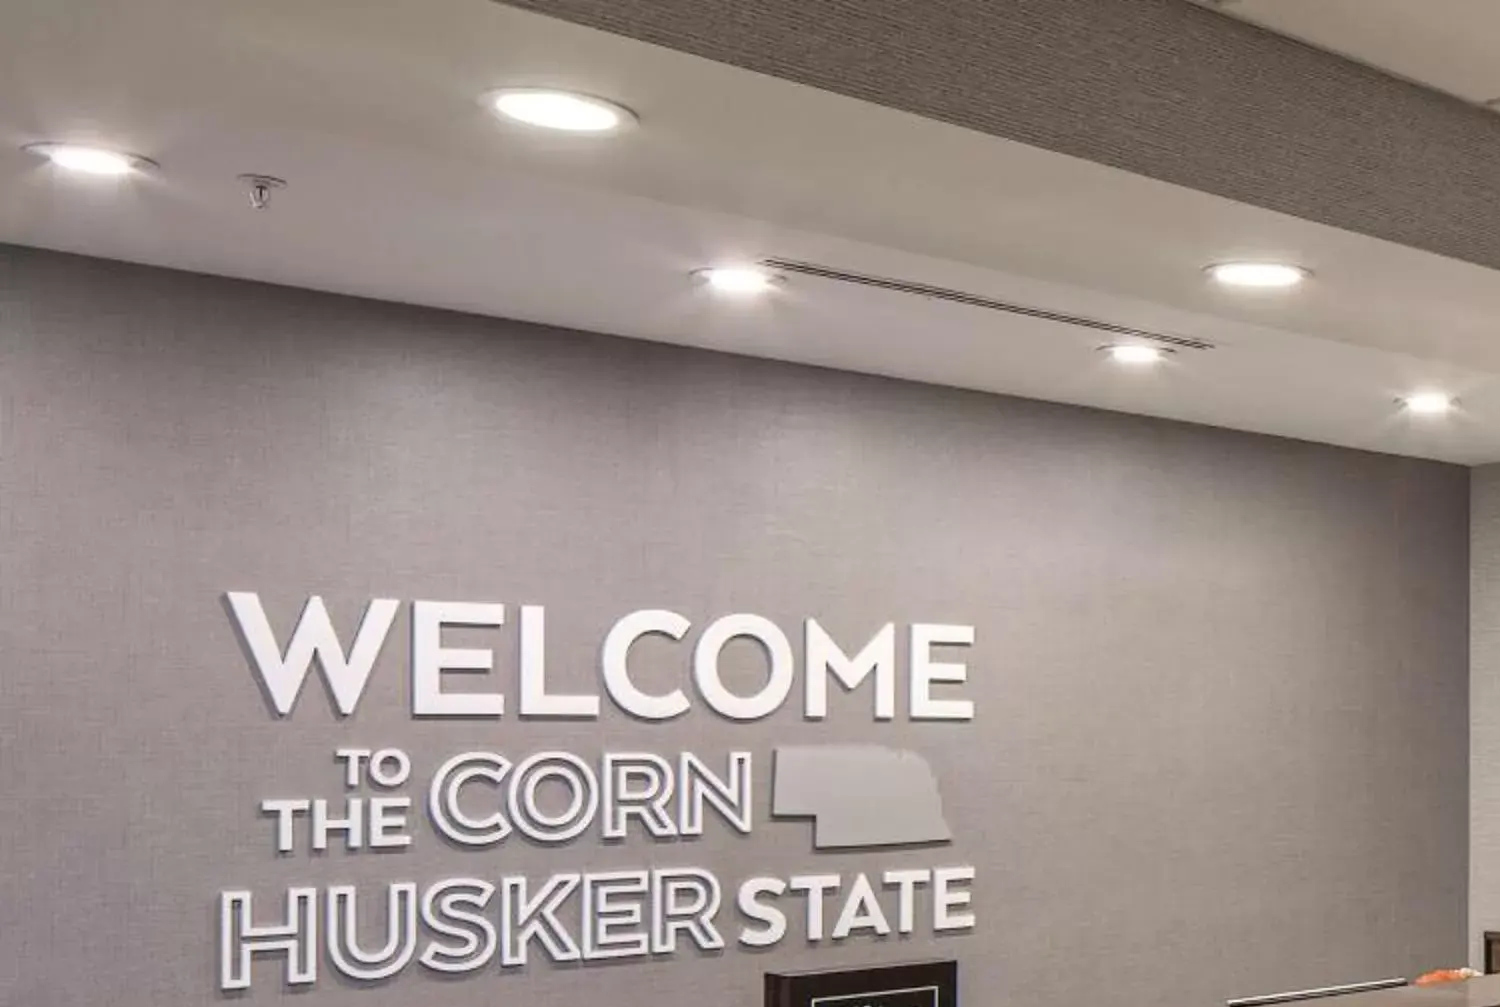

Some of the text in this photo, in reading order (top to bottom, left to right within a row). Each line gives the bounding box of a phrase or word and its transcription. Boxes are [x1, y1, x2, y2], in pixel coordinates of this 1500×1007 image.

[227, 591, 976, 721] WELCOME
[336, 749, 411, 787] TO
[428, 751, 752, 845] CORN
[262, 797, 411, 852] THE
[220, 866, 977, 990] HUSKER STATE
